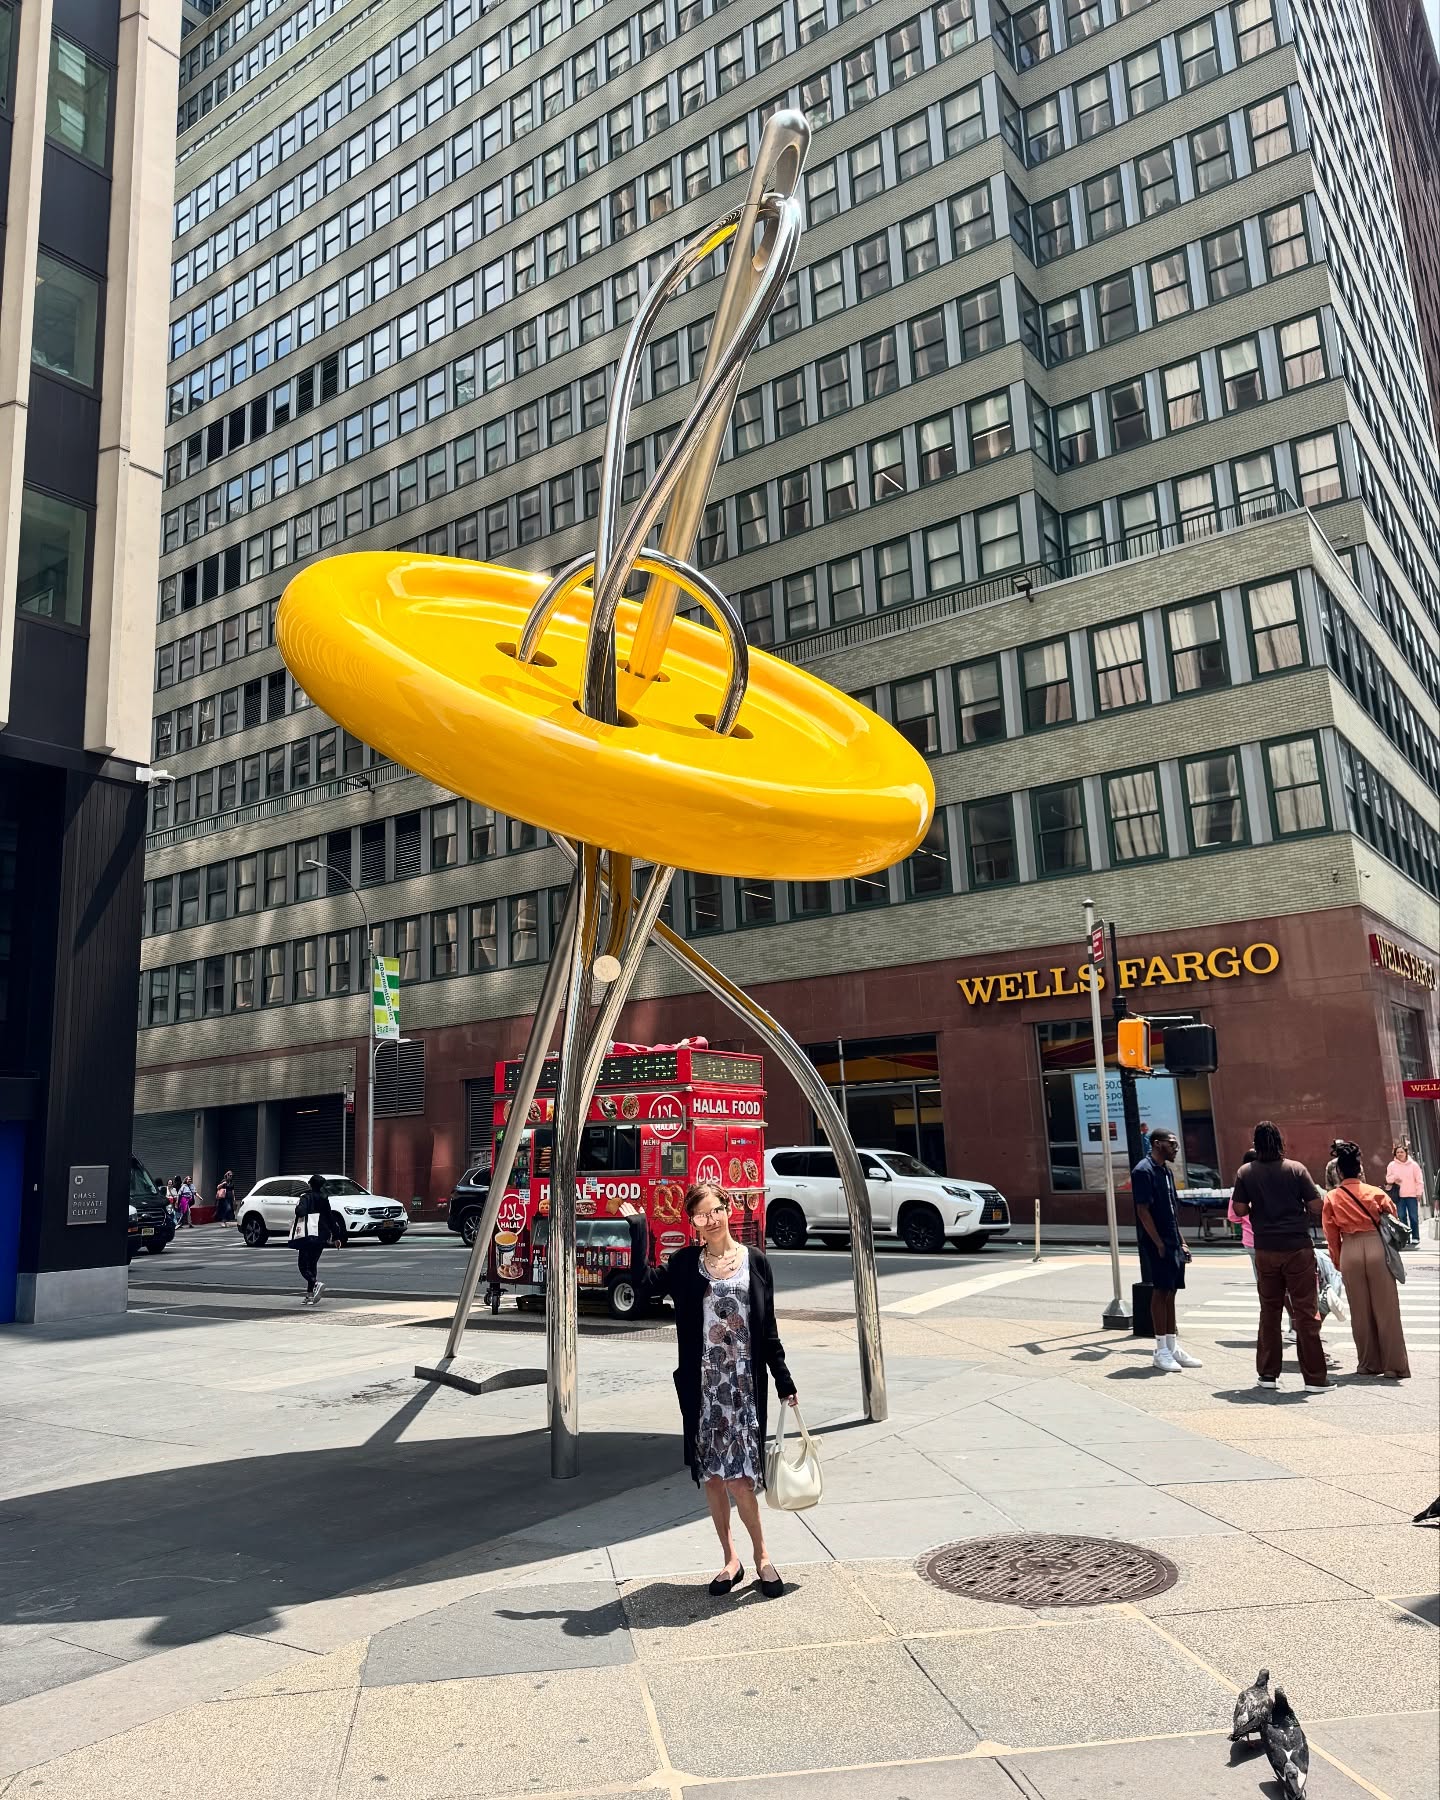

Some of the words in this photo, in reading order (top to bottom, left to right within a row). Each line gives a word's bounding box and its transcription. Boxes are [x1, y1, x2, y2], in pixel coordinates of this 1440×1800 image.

[957, 963, 1105, 1004] WELLS
[1117, 943, 1279, 988] FARGO
[693, 1098, 729, 1114] HALAL
[732, 1100, 760, 1115] FOOD
[655, 1123, 678, 1131] HALAL
[540, 1184, 591, 1200] HAL
[596, 1183, 641, 1200] FOOD
[72, 1208, 98, 1216] CLIENT
[501, 1221, 520, 1229] HALAL
